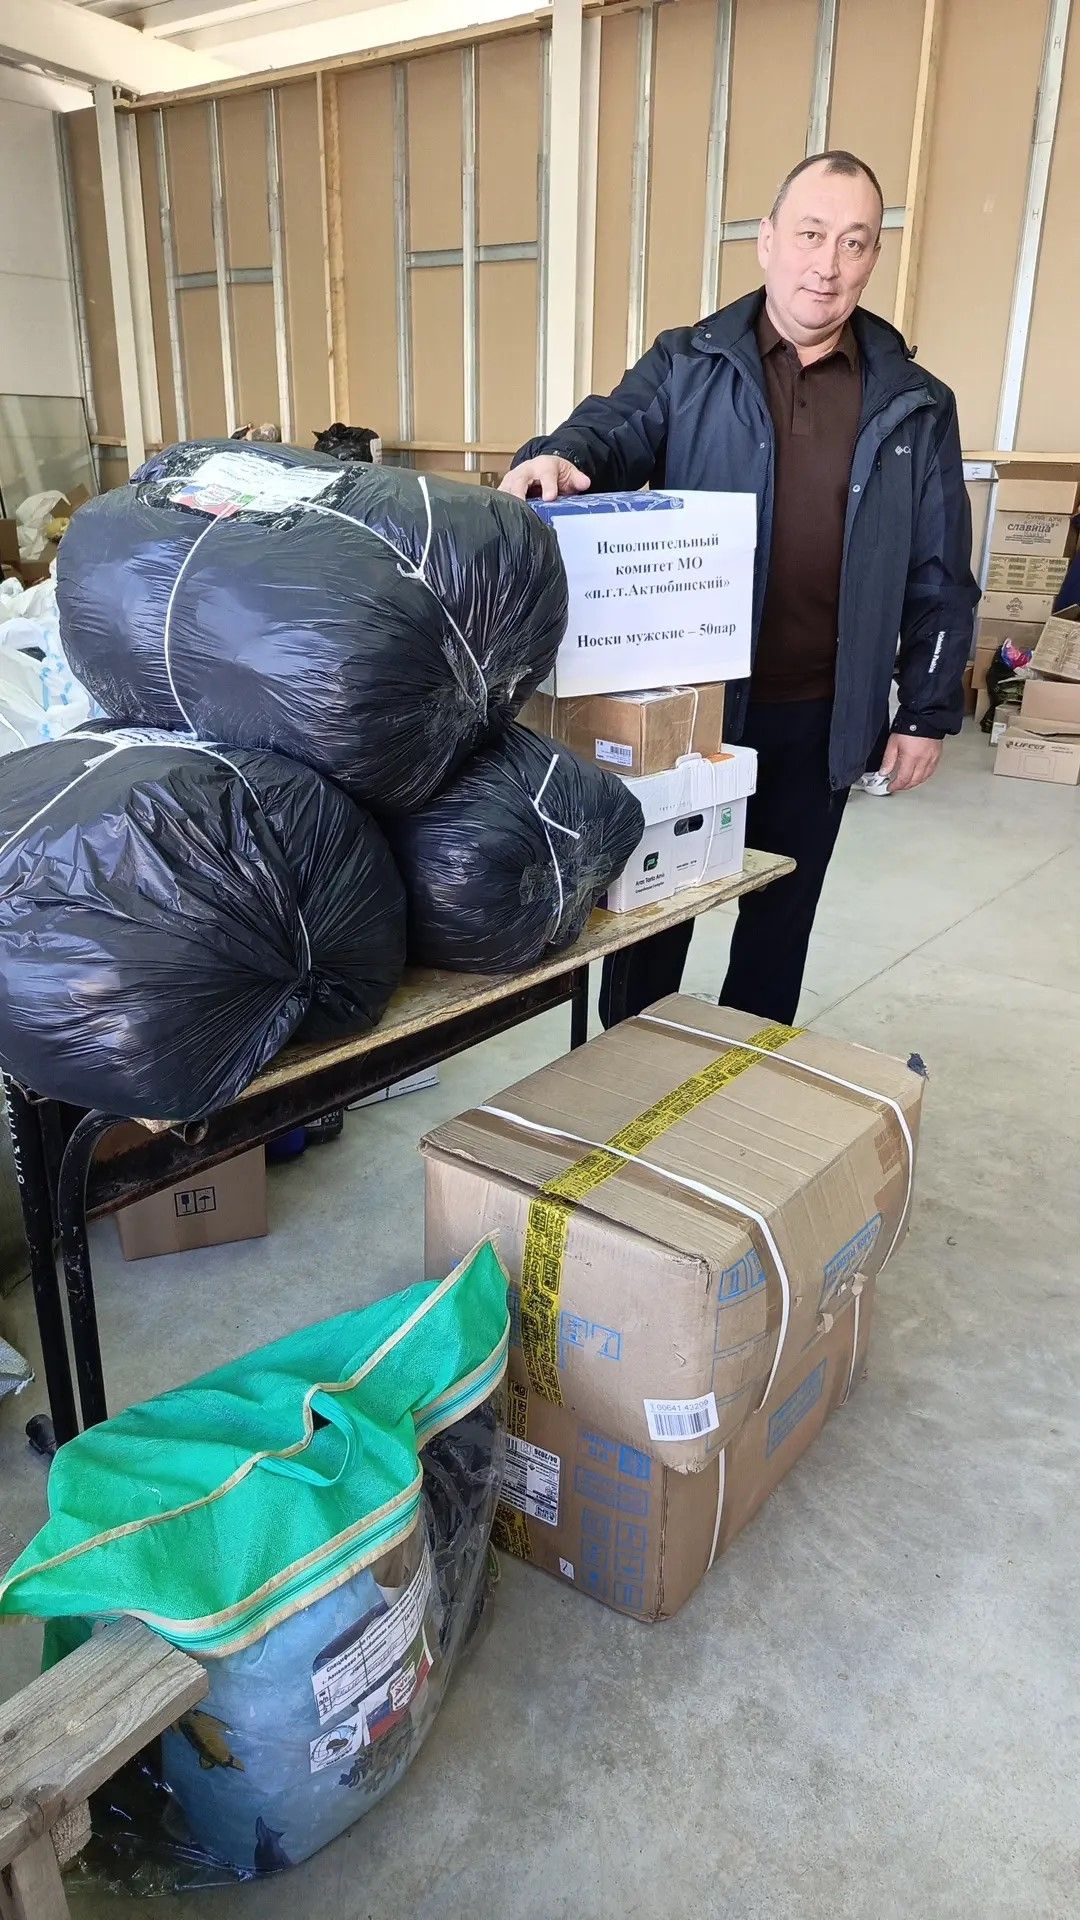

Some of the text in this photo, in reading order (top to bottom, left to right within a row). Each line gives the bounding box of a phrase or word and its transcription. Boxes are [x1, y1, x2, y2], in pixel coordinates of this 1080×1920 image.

[597, 533, 719, 555] Исполнительный
[615, 556, 703, 576] комитет МО
[584, 575, 730, 600] «п.г.т.Актюбинский»
[577, 632, 621, 648] Носки
[626, 629, 684, 646] мужские
[699, 622, 736, 638] 50пар
